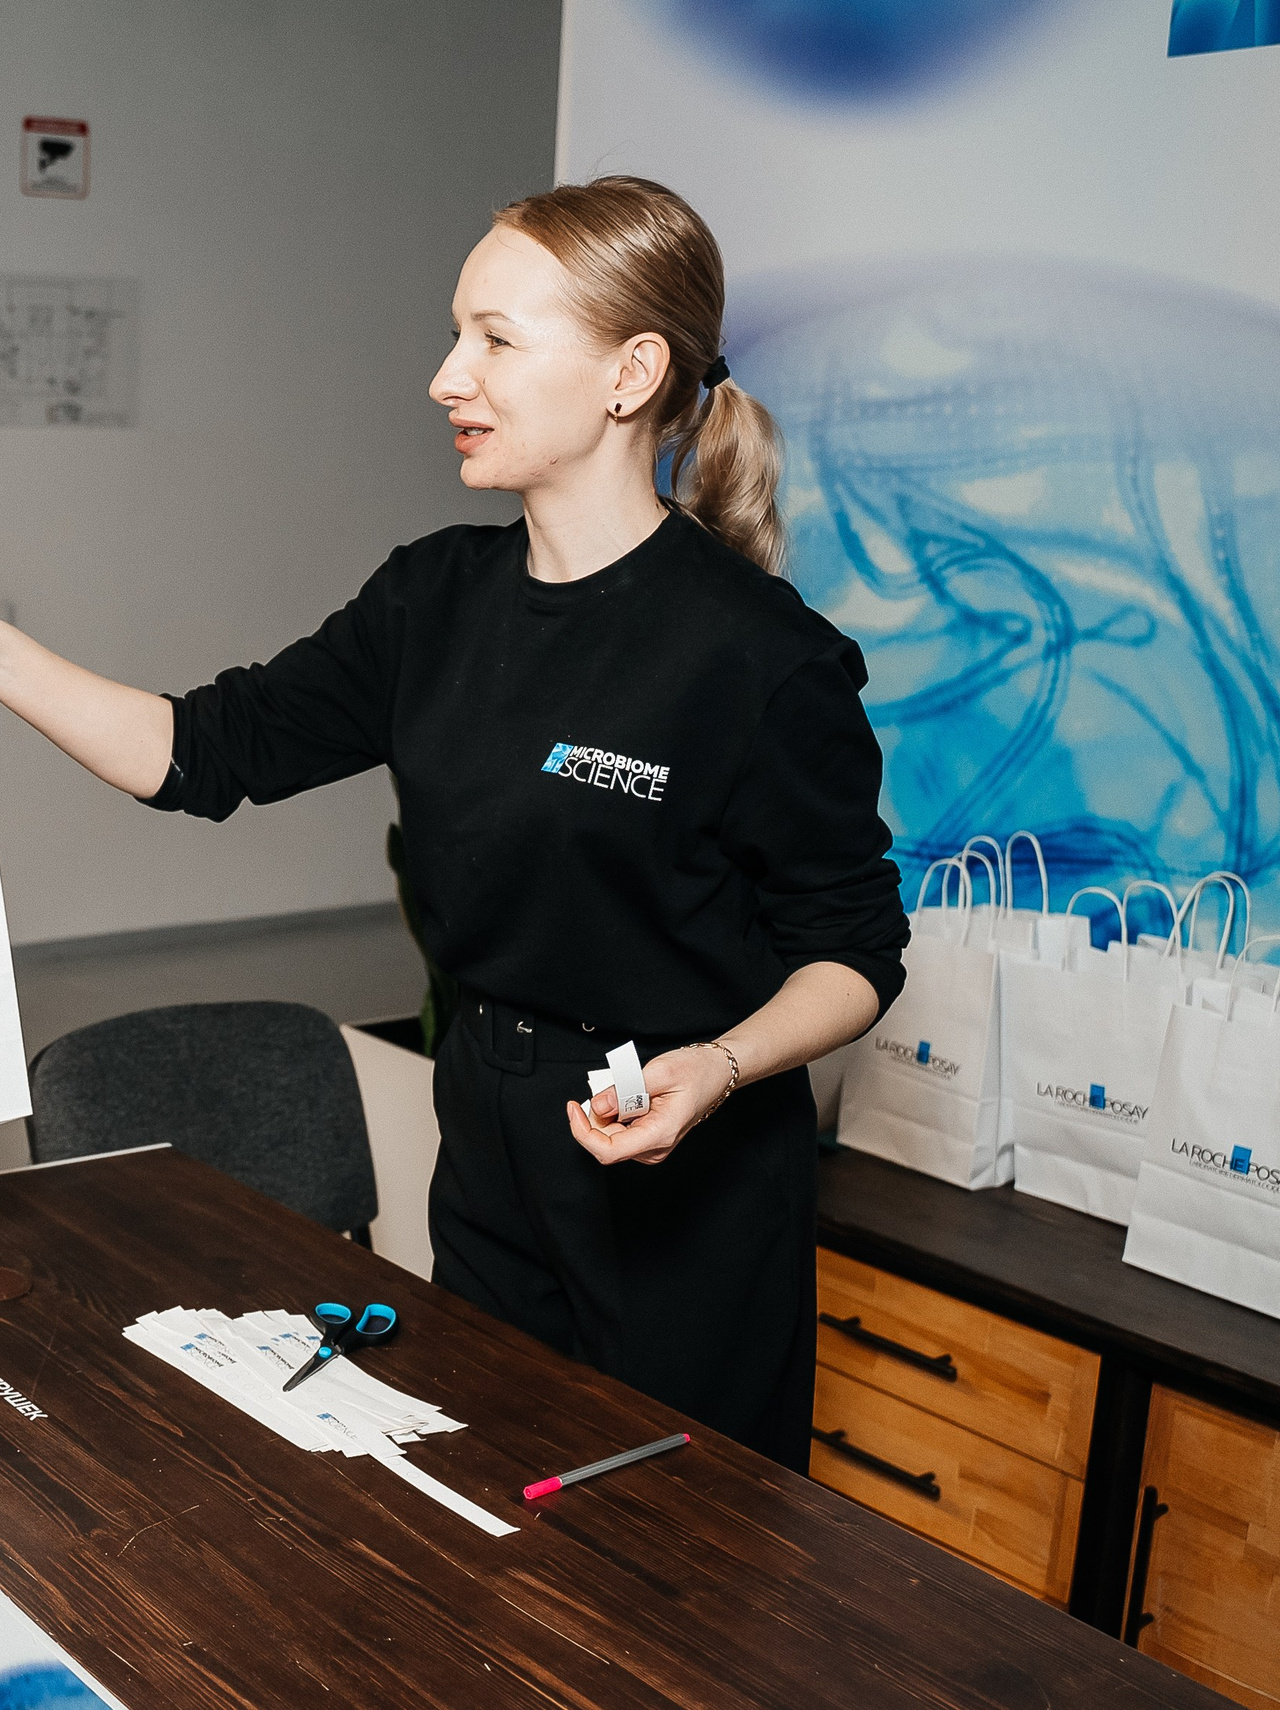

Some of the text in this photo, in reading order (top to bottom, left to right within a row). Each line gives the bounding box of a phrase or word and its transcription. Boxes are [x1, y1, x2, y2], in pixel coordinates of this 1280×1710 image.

[558, 756, 667, 801] SCIENCE
[570, 745, 670, 780] MICROBIOME
[1037, 1082, 1053, 1097] LA
[1103, 1098, 1148, 1119] POSAY
[1171, 1138, 1280, 1185] LA ROCHE POS
